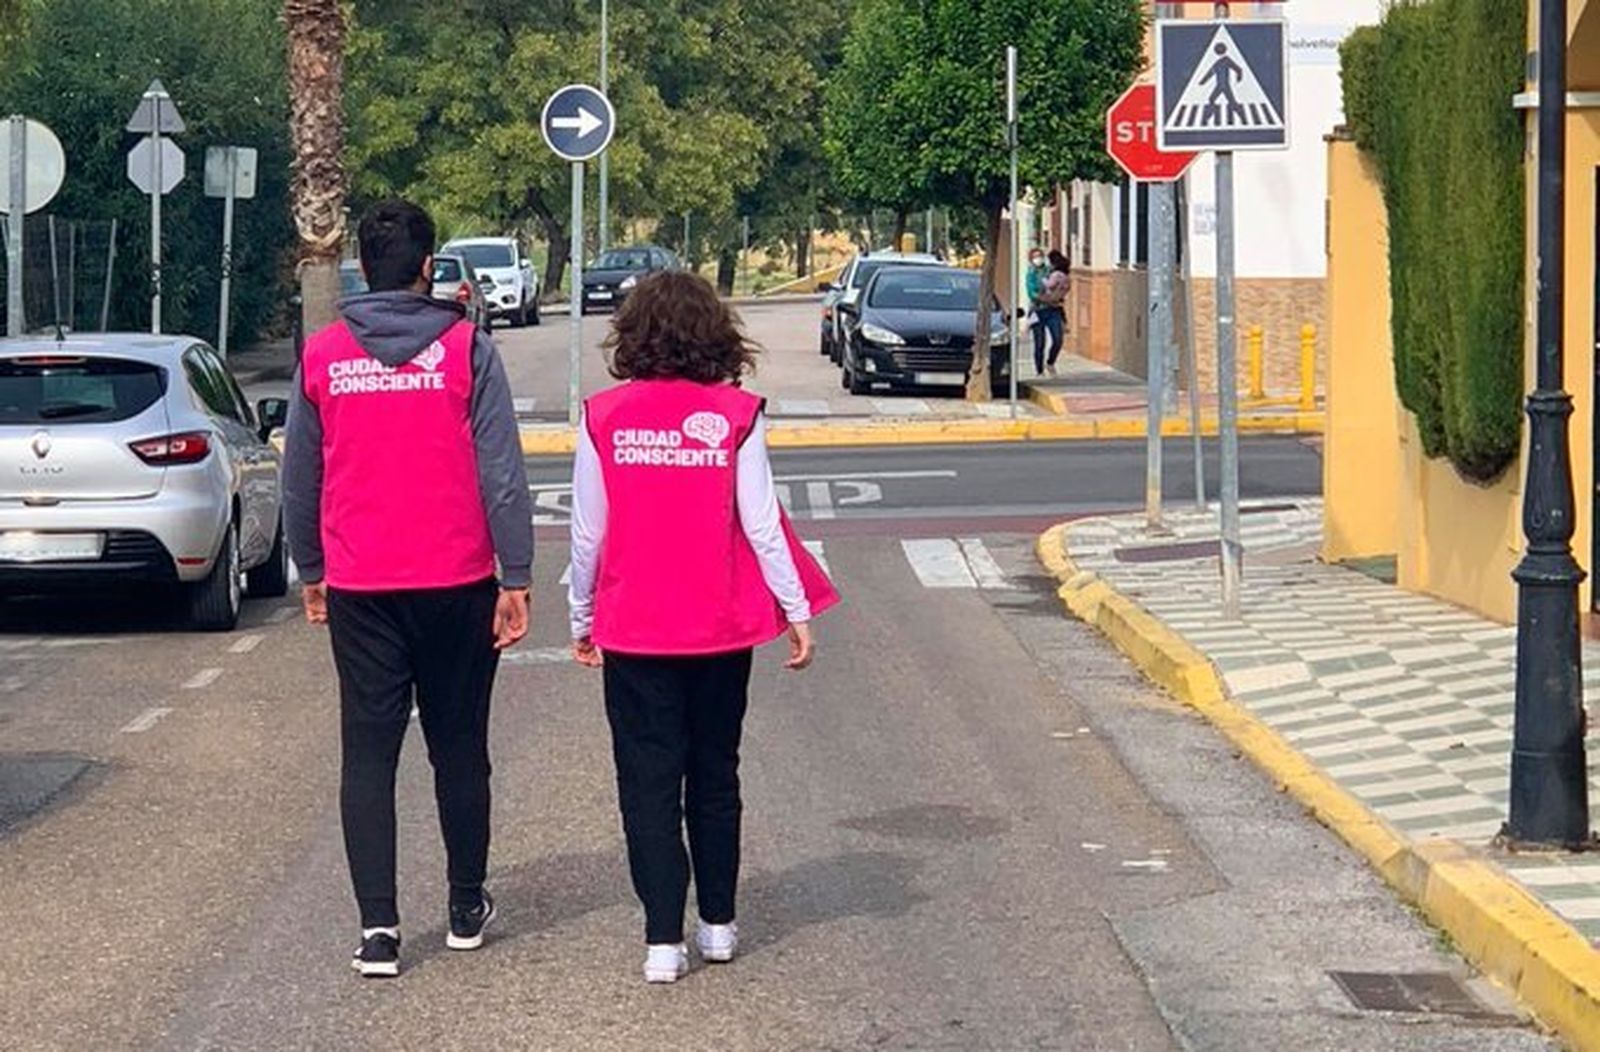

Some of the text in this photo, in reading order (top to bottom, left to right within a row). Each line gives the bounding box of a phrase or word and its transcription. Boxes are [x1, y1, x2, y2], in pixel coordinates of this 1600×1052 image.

[1116, 121, 1154, 143] ST
[328, 371, 446, 396] CONSCIENTE
[612, 429, 682, 447] CIUDAD
[613, 447, 729, 467] CONSCIENTE
